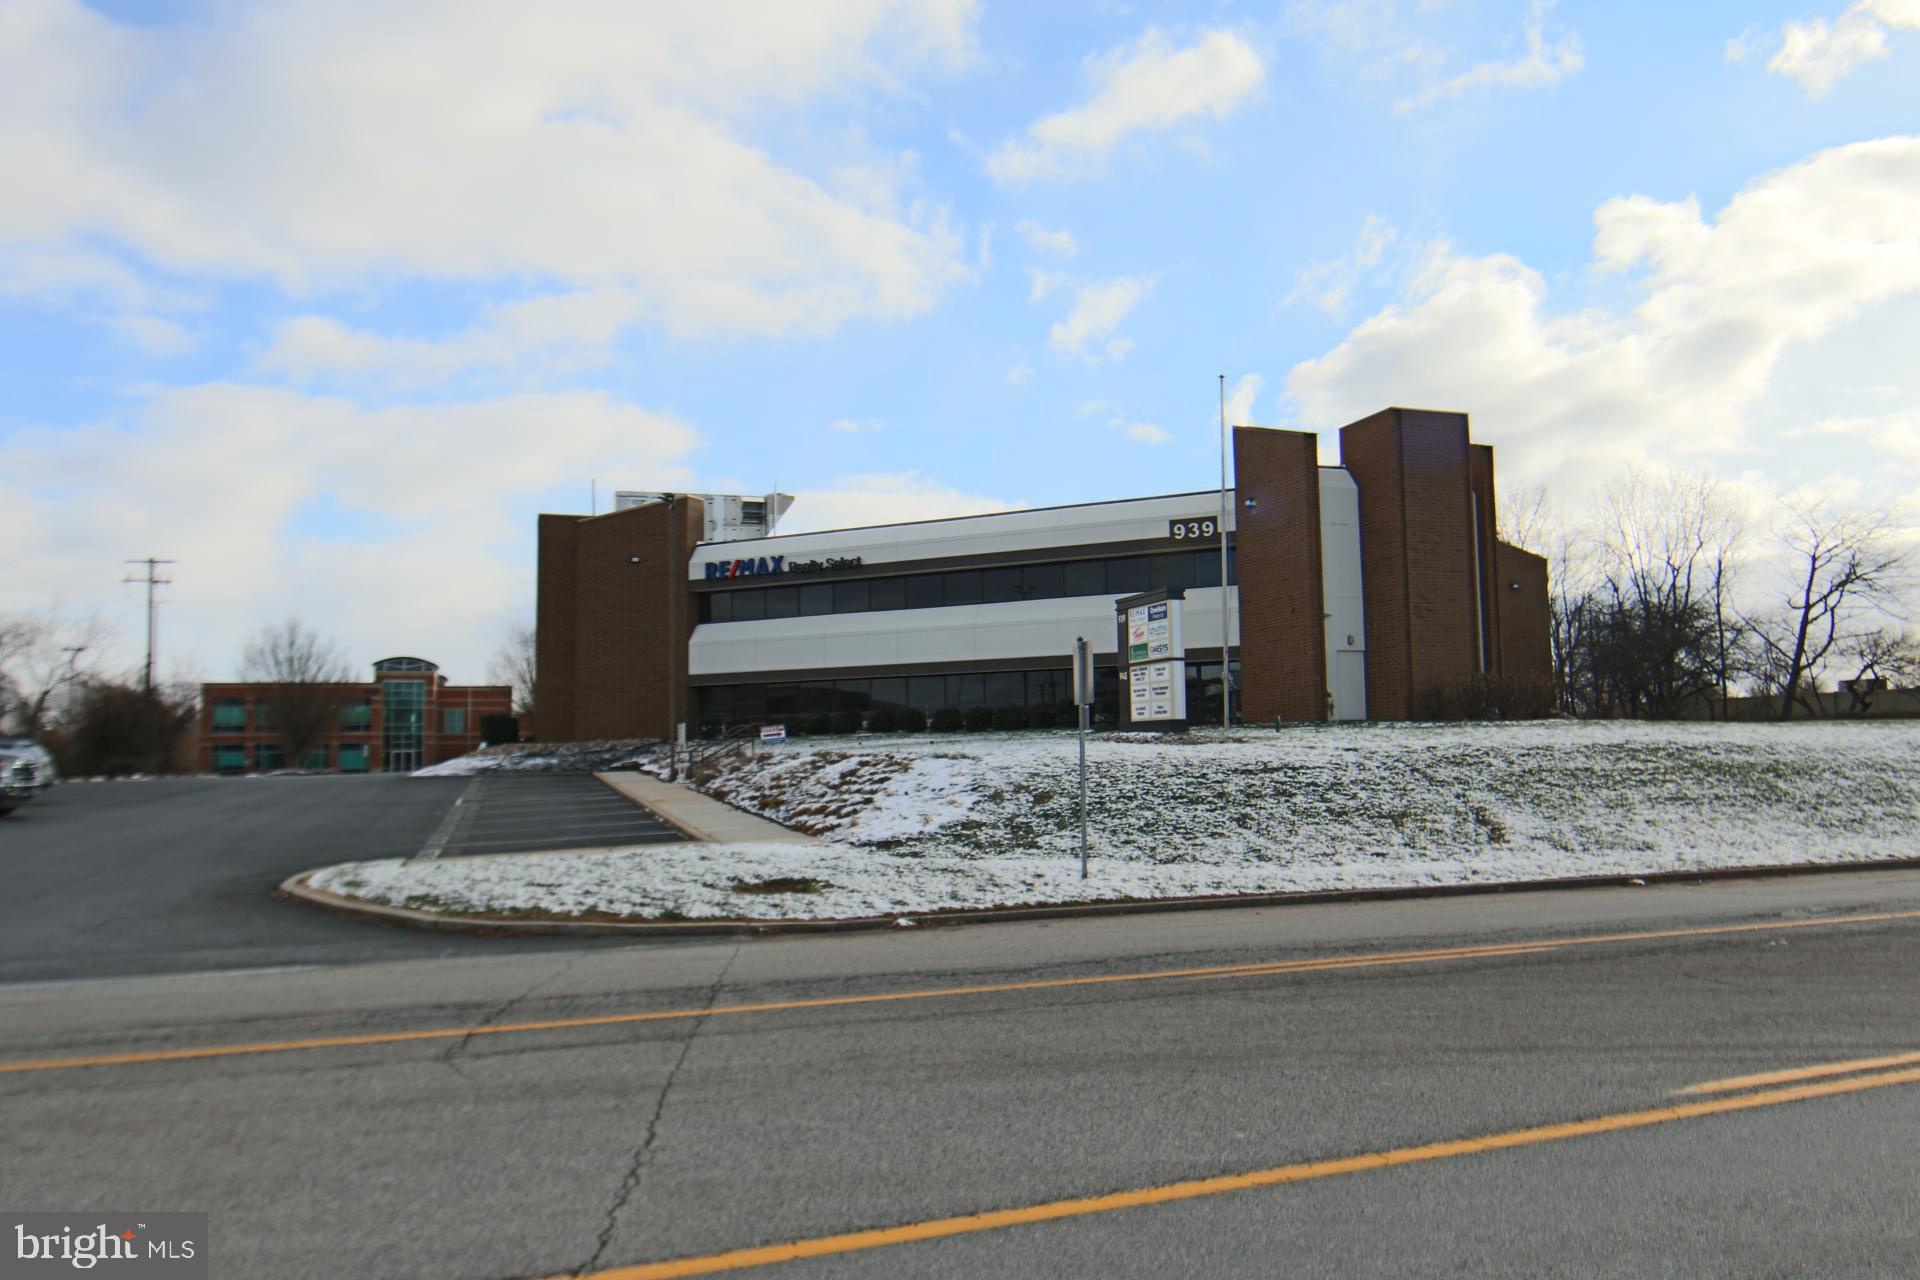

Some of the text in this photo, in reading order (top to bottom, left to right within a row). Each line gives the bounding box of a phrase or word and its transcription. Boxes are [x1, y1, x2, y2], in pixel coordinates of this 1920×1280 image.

[1173, 521, 1214, 539] 939
[704, 555, 863, 580] RE/MAX Realty Select
